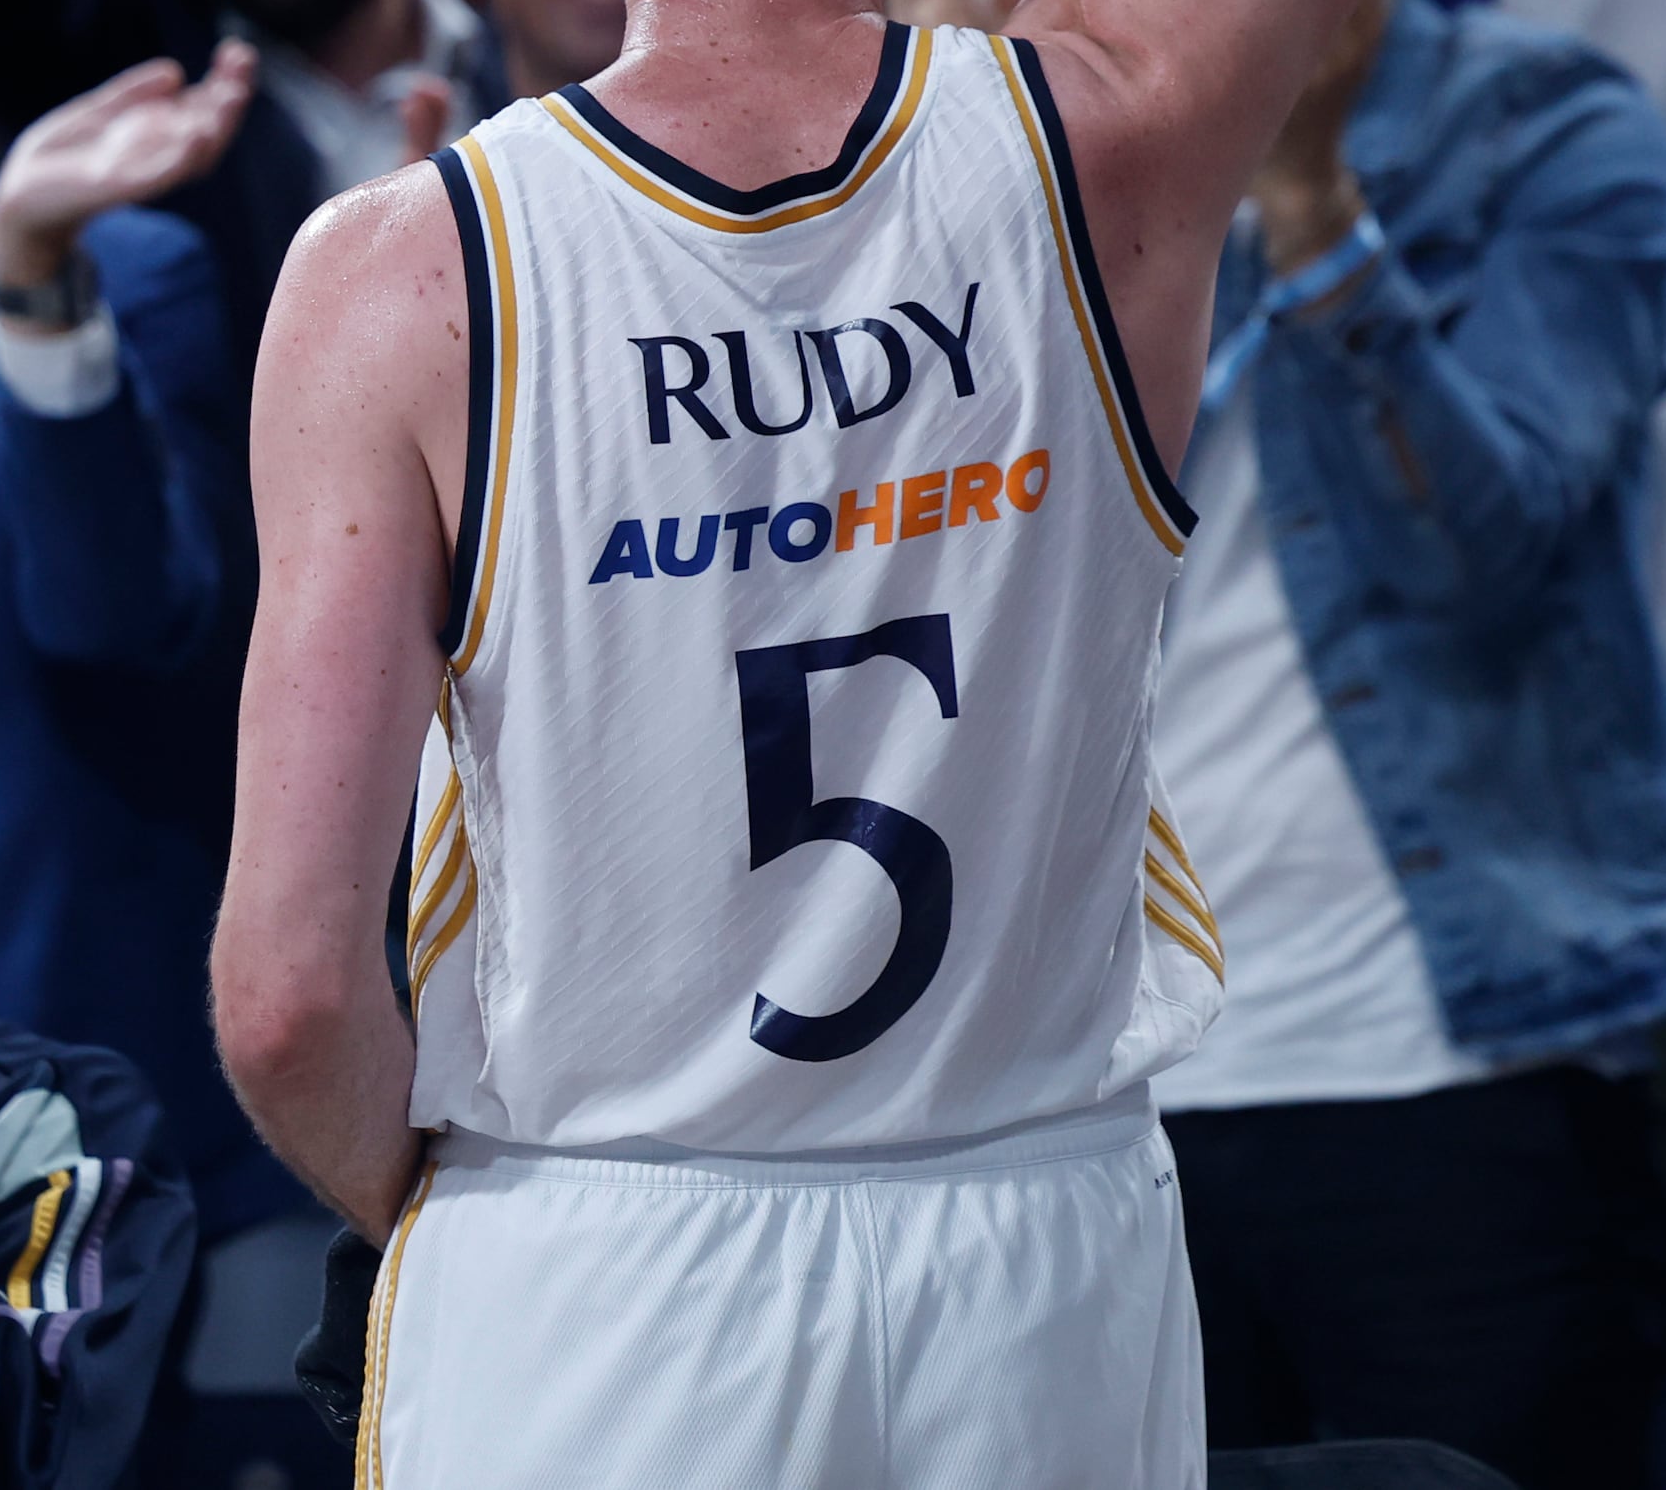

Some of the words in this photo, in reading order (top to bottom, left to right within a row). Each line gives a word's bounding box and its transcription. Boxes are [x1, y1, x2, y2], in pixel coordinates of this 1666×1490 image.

[627, 282, 980, 444] RUDY
[588, 449, 1050, 584] AUTOHERO
[735, 613, 958, 1062] 5
